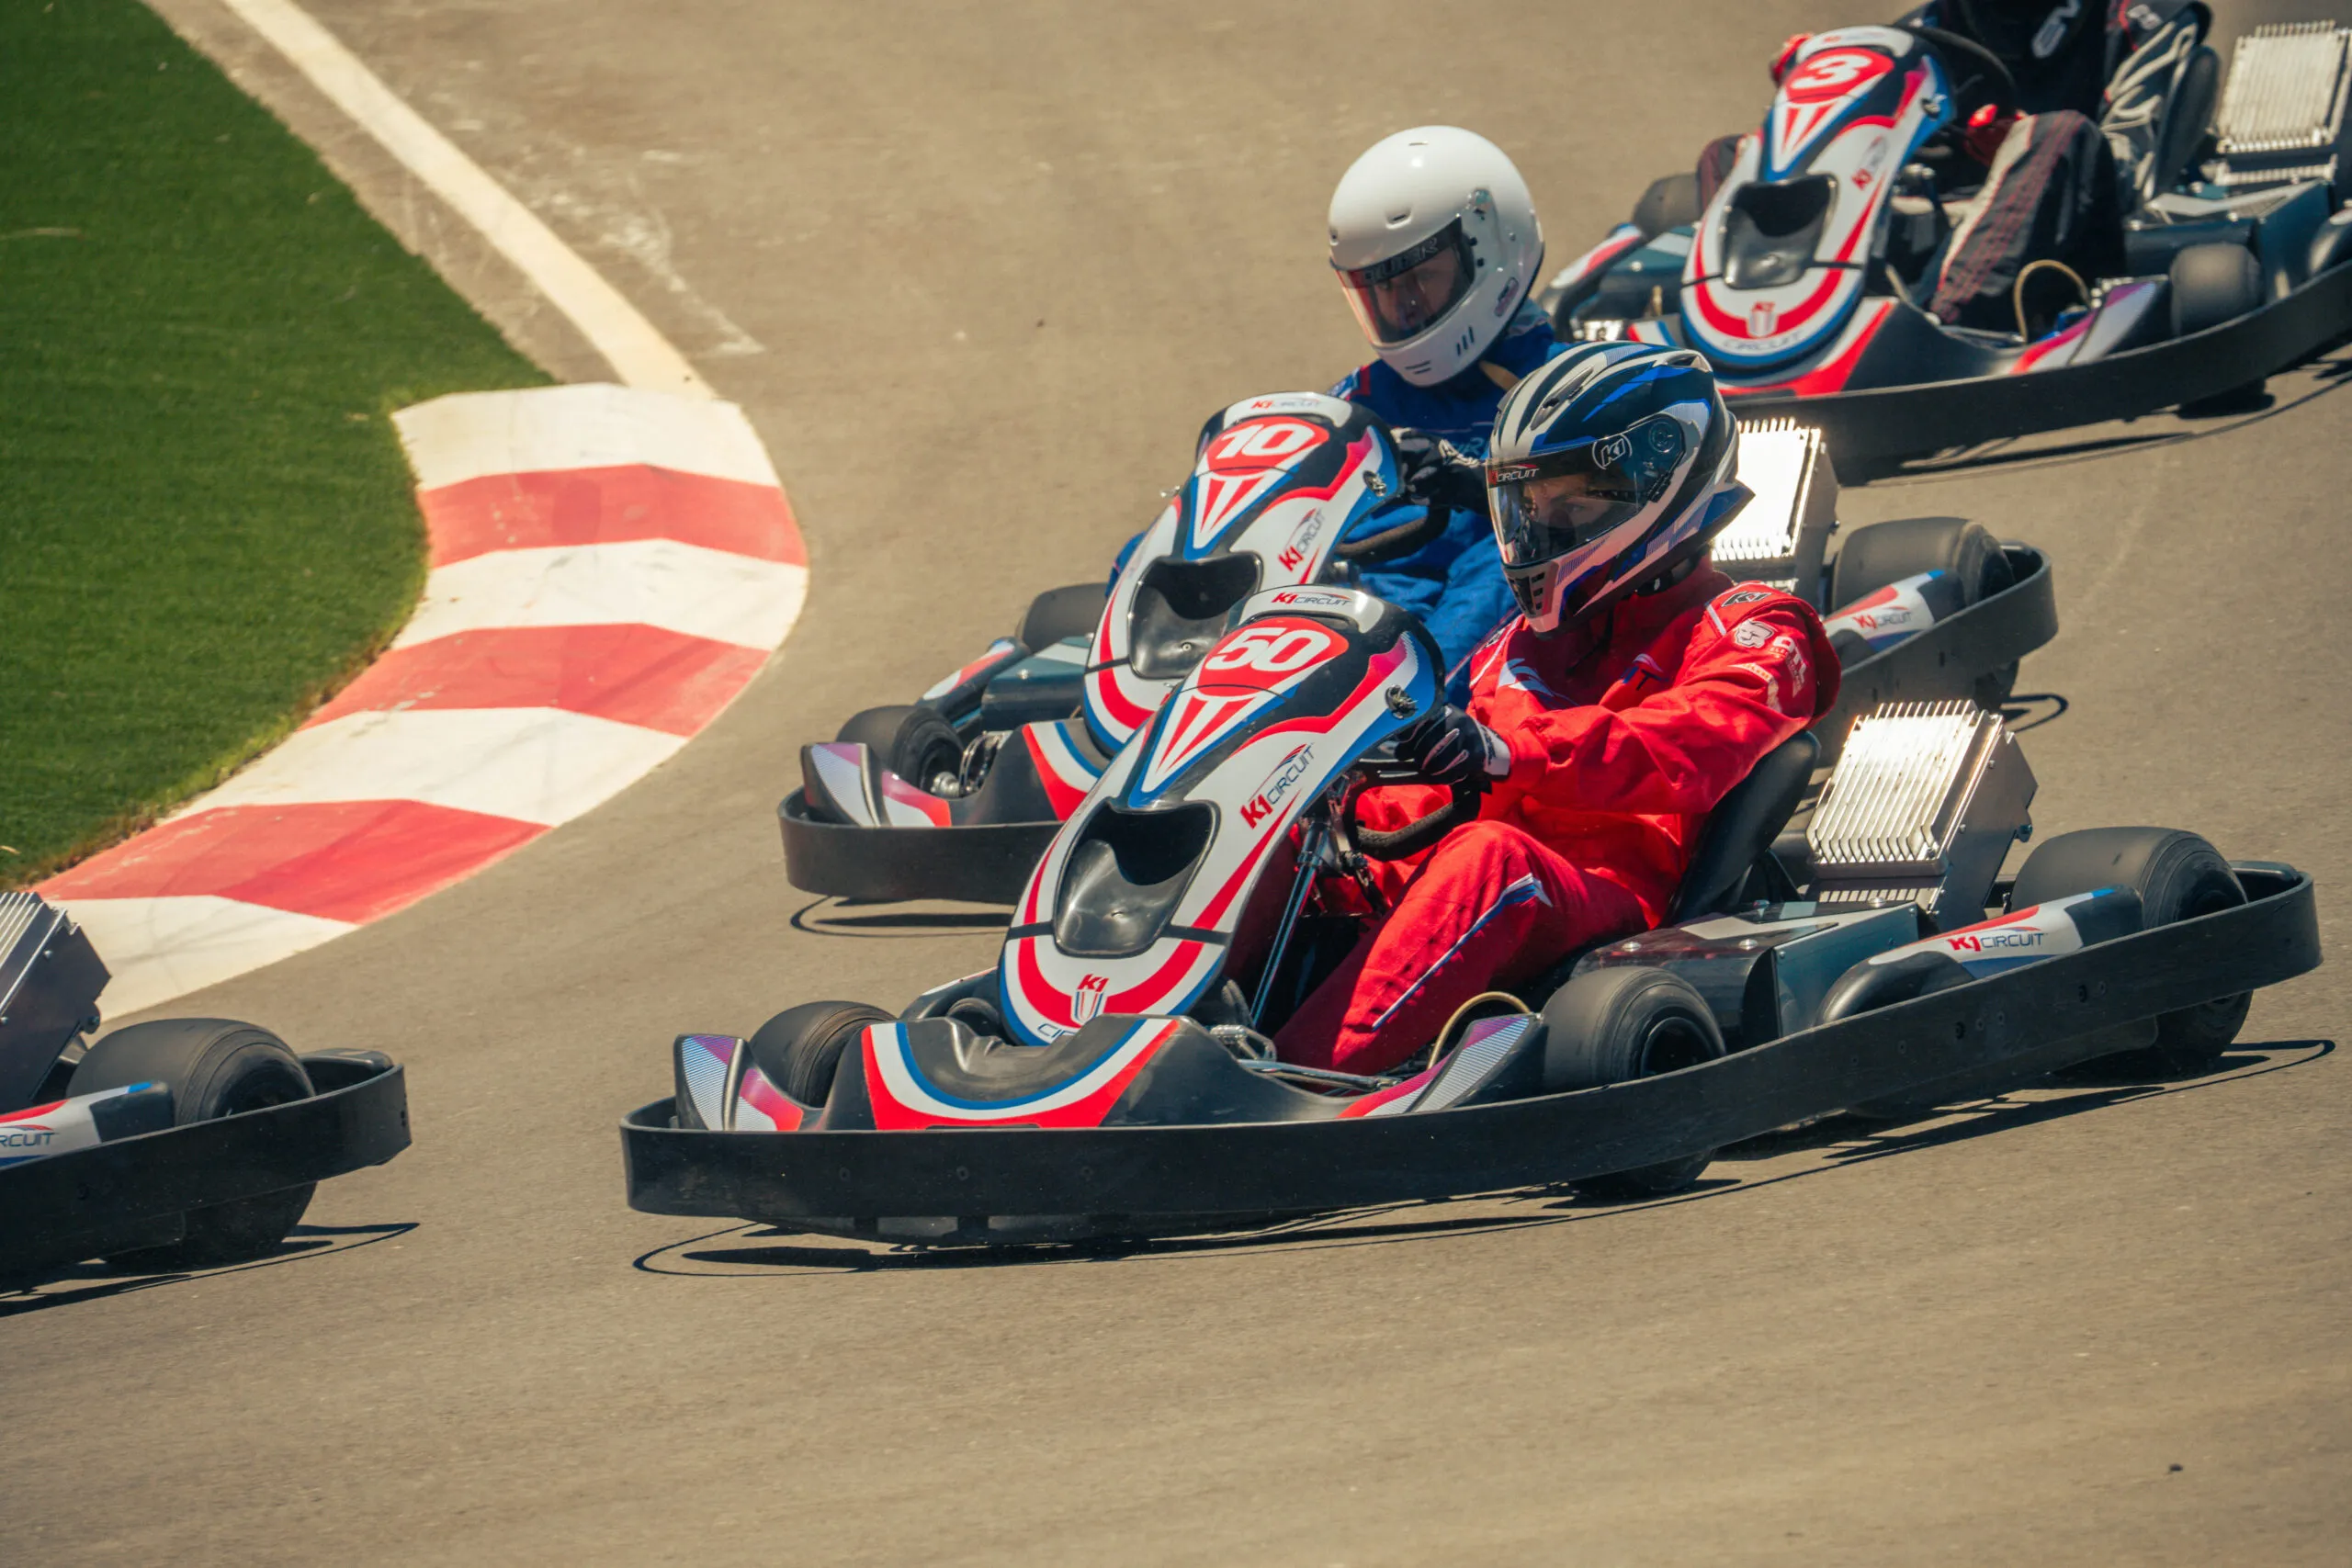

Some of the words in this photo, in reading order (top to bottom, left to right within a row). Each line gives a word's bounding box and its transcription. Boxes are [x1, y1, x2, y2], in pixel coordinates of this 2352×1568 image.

[1790, 54, 1872, 90] 3
[1216, 423, 1316, 459] 10
[1278, 545, 1304, 572] K1
[1271, 592, 1299, 604] K1
[1295, 596, 1351, 606] CIRCUIT
[1205, 626, 1331, 672] 50
[1239, 793, 1274, 830] K1
[1267, 744, 1315, 806] CIRCUIT
[1946, 935, 1982, 953] K1
[1980, 932, 2044, 949] CIRCUIT
[1077, 973, 1110, 993] K1
